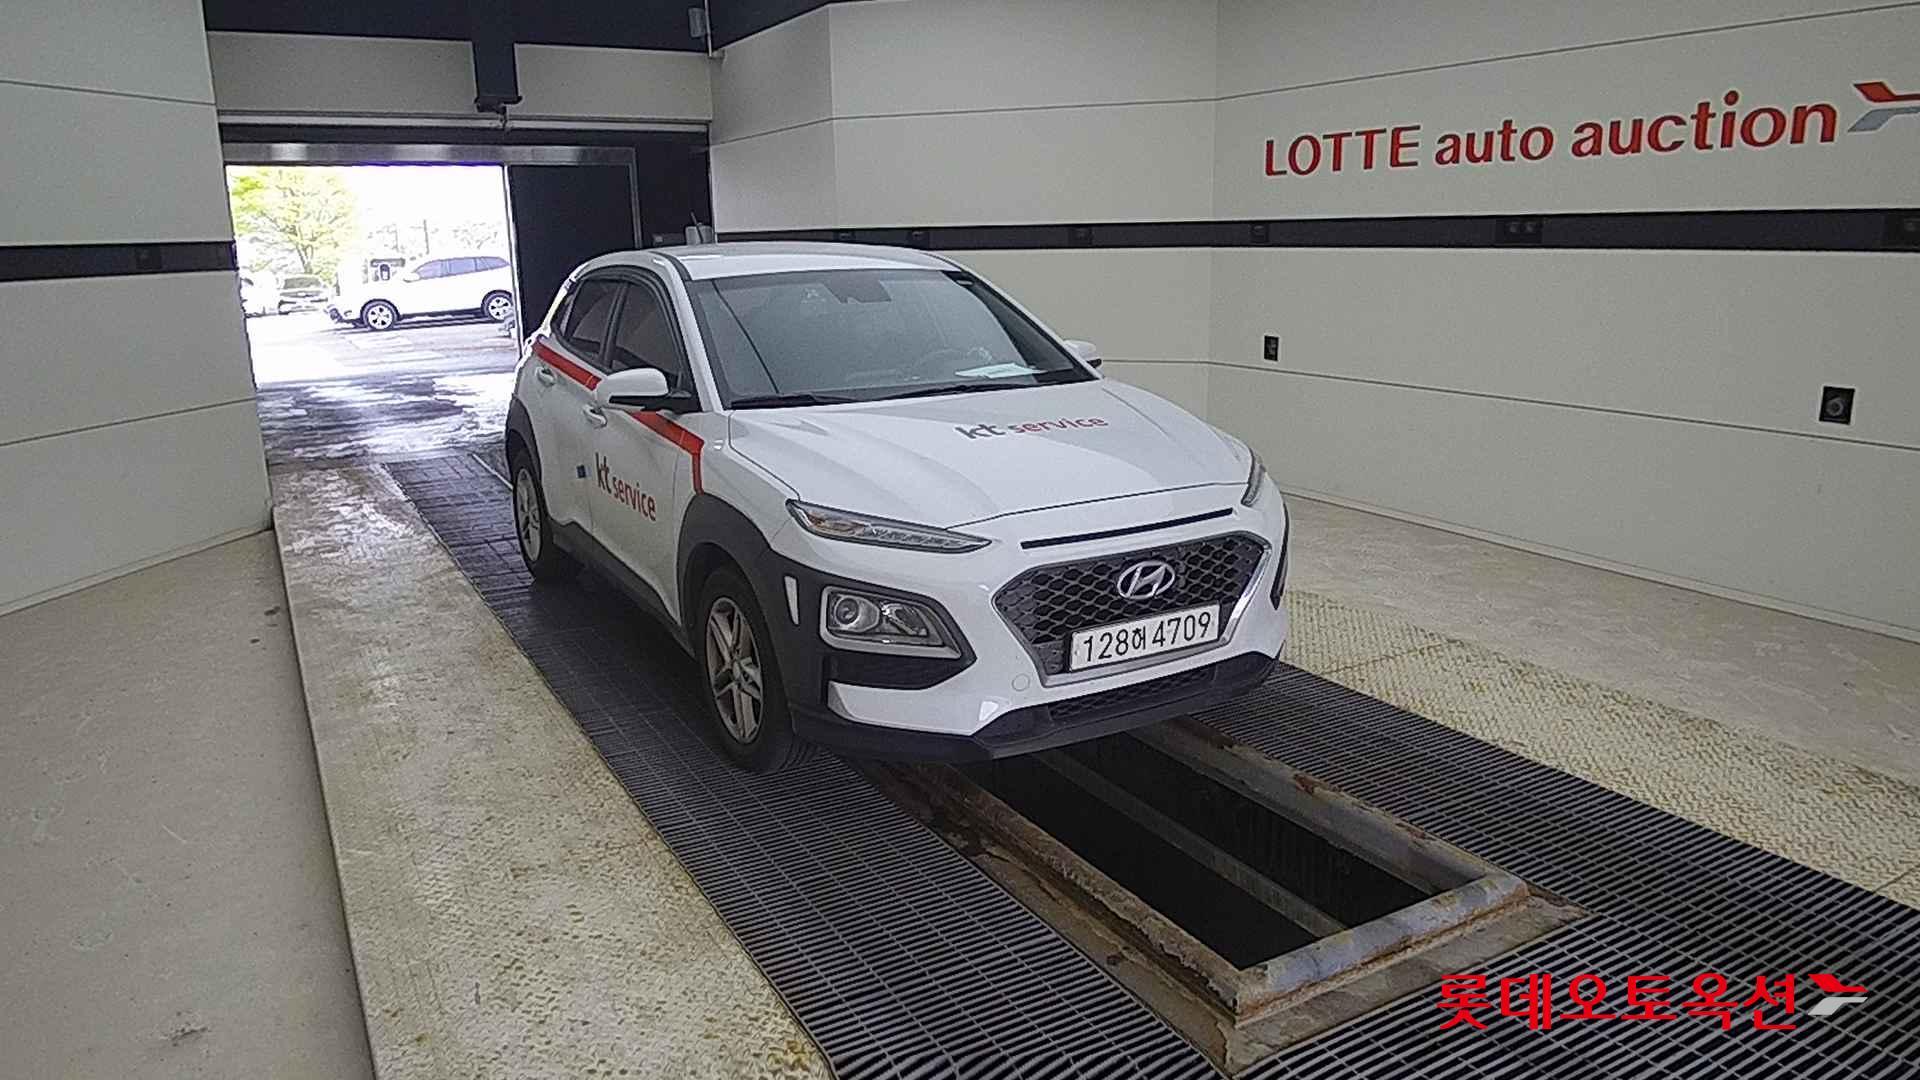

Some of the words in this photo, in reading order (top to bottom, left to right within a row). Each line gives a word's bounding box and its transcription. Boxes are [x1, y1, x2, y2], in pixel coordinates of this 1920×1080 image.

[1265, 124, 1421, 177] LOTTE
[1434, 118, 1554, 167] auto
[1571, 90, 1838, 158] auction
[955, 424, 1006, 439] kt
[1008, 418, 1109, 434] service
[595, 452, 611, 494] kt
[612, 477, 656, 521] service
